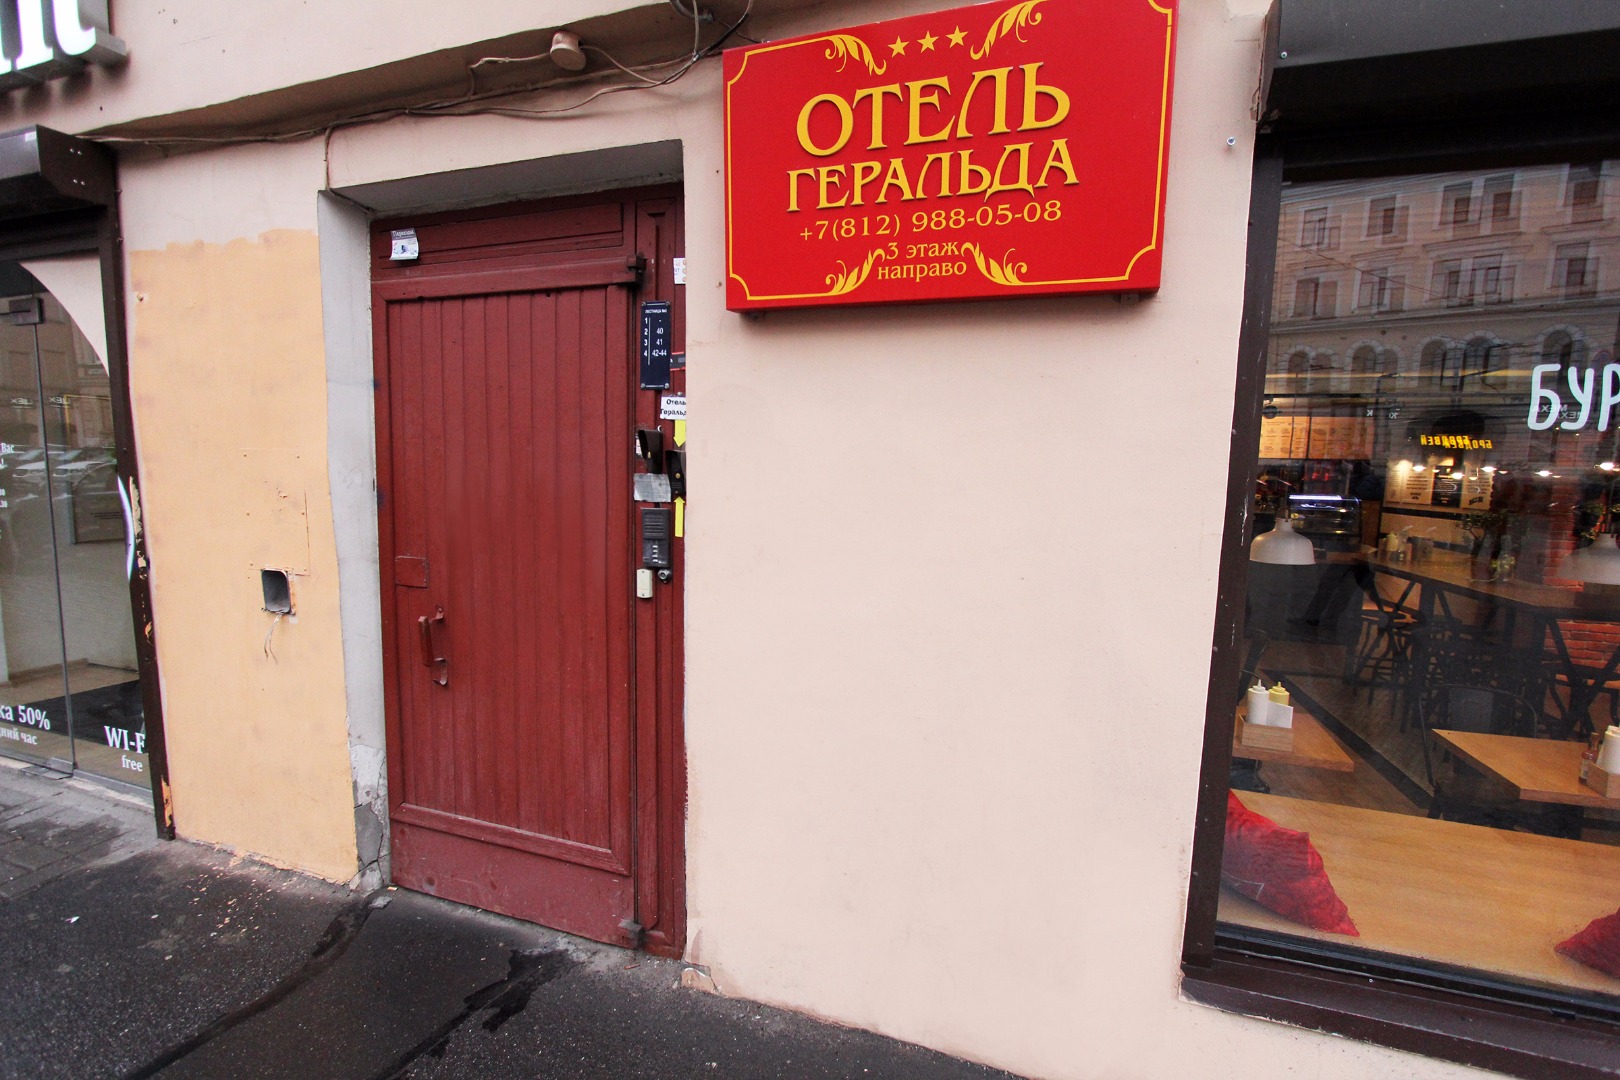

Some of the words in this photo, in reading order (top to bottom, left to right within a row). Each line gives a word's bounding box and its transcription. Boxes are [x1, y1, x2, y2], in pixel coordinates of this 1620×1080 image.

[796, 62, 1071, 157] ОТЕЛЬ
[786, 138, 1080, 213] ГЕРАЛЬДА
[800, 213, 901, 241] +7(812)
[911, 200, 1063, 232] 988-05-08
[886, 242, 899, 260] 3
[905, 241, 961, 260] этаж
[876, 261, 968, 282] направо
[644, 317, 649, 325] 1
[644, 327, 649, 336] 2
[656, 327, 664, 335] 40
[643, 338, 648, 346] 3
[656, 338, 663, 346] 41
[643, 349, 648, 357] 4
[651, 349, 667, 357] 42-44
[666, 398, 686, 406] Отель
[1527, 363, 1620, 432] БУР
[18, 704, 51, 731] 50%
[20, 732, 38, 745] час
[121, 754, 143, 772] free
